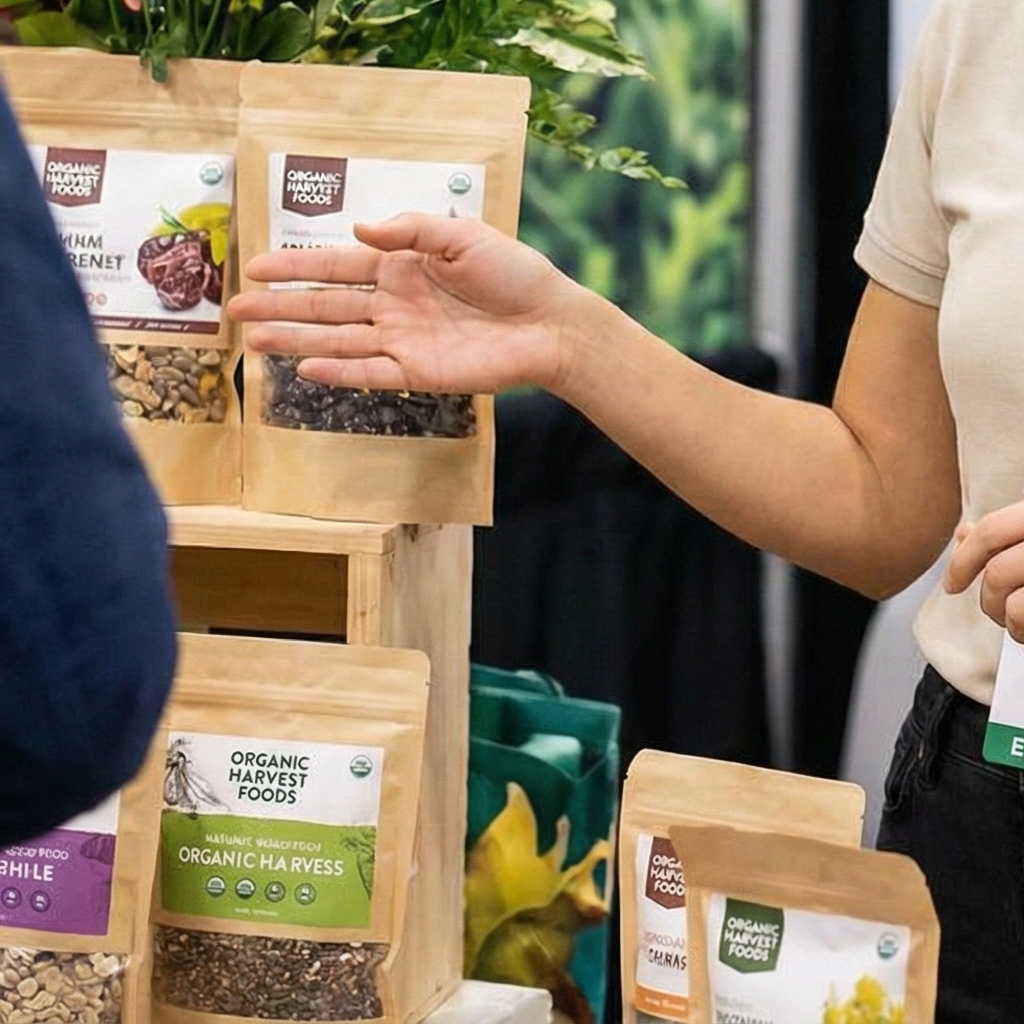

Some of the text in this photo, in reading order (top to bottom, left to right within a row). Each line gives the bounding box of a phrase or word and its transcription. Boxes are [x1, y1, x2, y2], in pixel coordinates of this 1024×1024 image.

[231, 751, 310, 770] ORGANIC
[229, 768, 308, 788] HARVEST
[238, 786, 297, 804] FOODS
[179, 846, 256, 869] ORGANIC
[727, 917, 780, 937] ORGANIC
